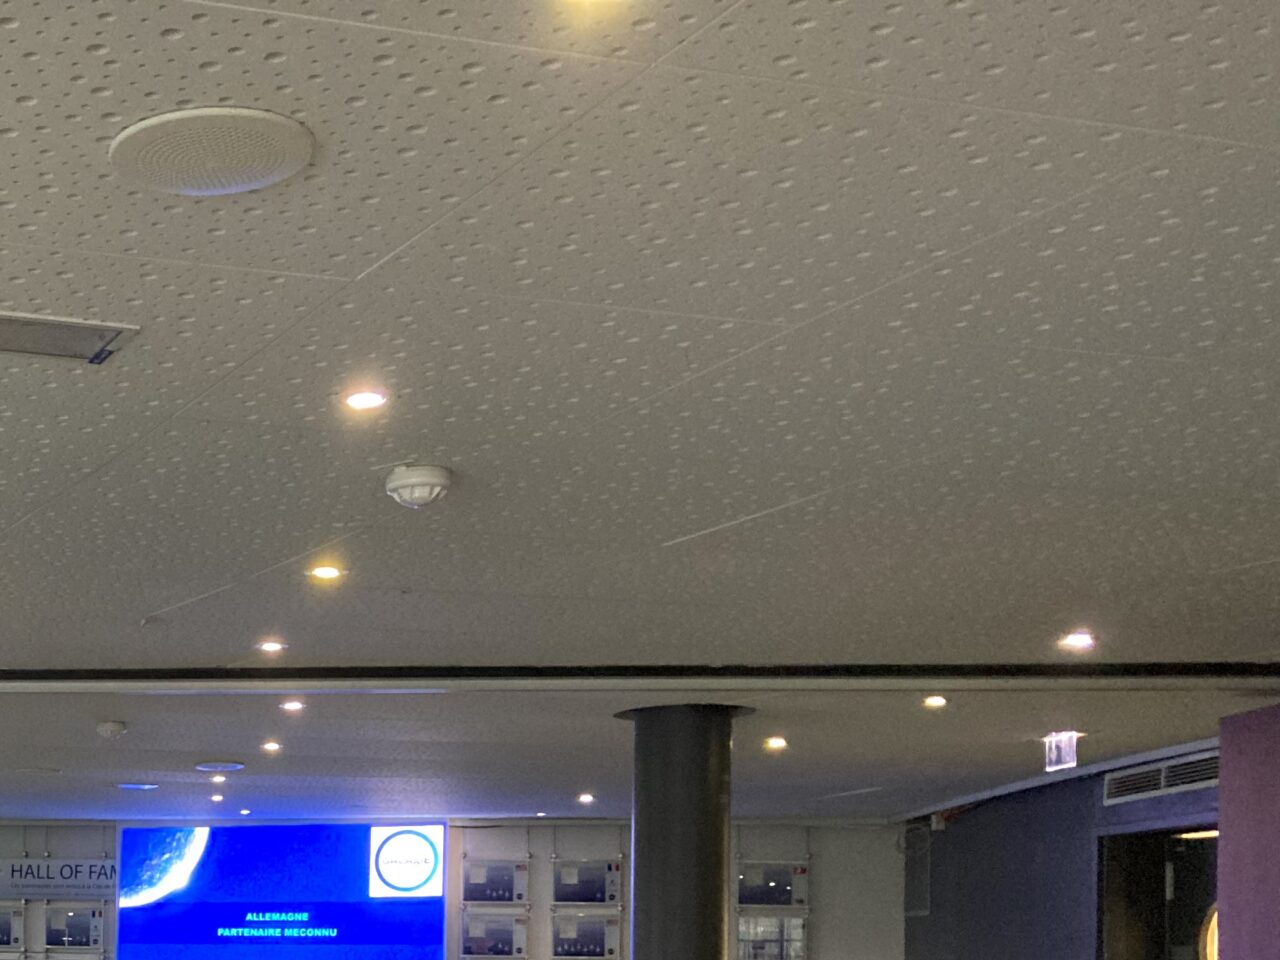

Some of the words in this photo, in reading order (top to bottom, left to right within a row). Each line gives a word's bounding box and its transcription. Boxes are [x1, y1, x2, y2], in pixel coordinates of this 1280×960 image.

[10, 863, 55, 880] HALL
[59, 863, 83, 880] OF
[245, 912, 309, 921] ALLEMAGNE
[217, 927, 282, 937] PARTENAIRE
